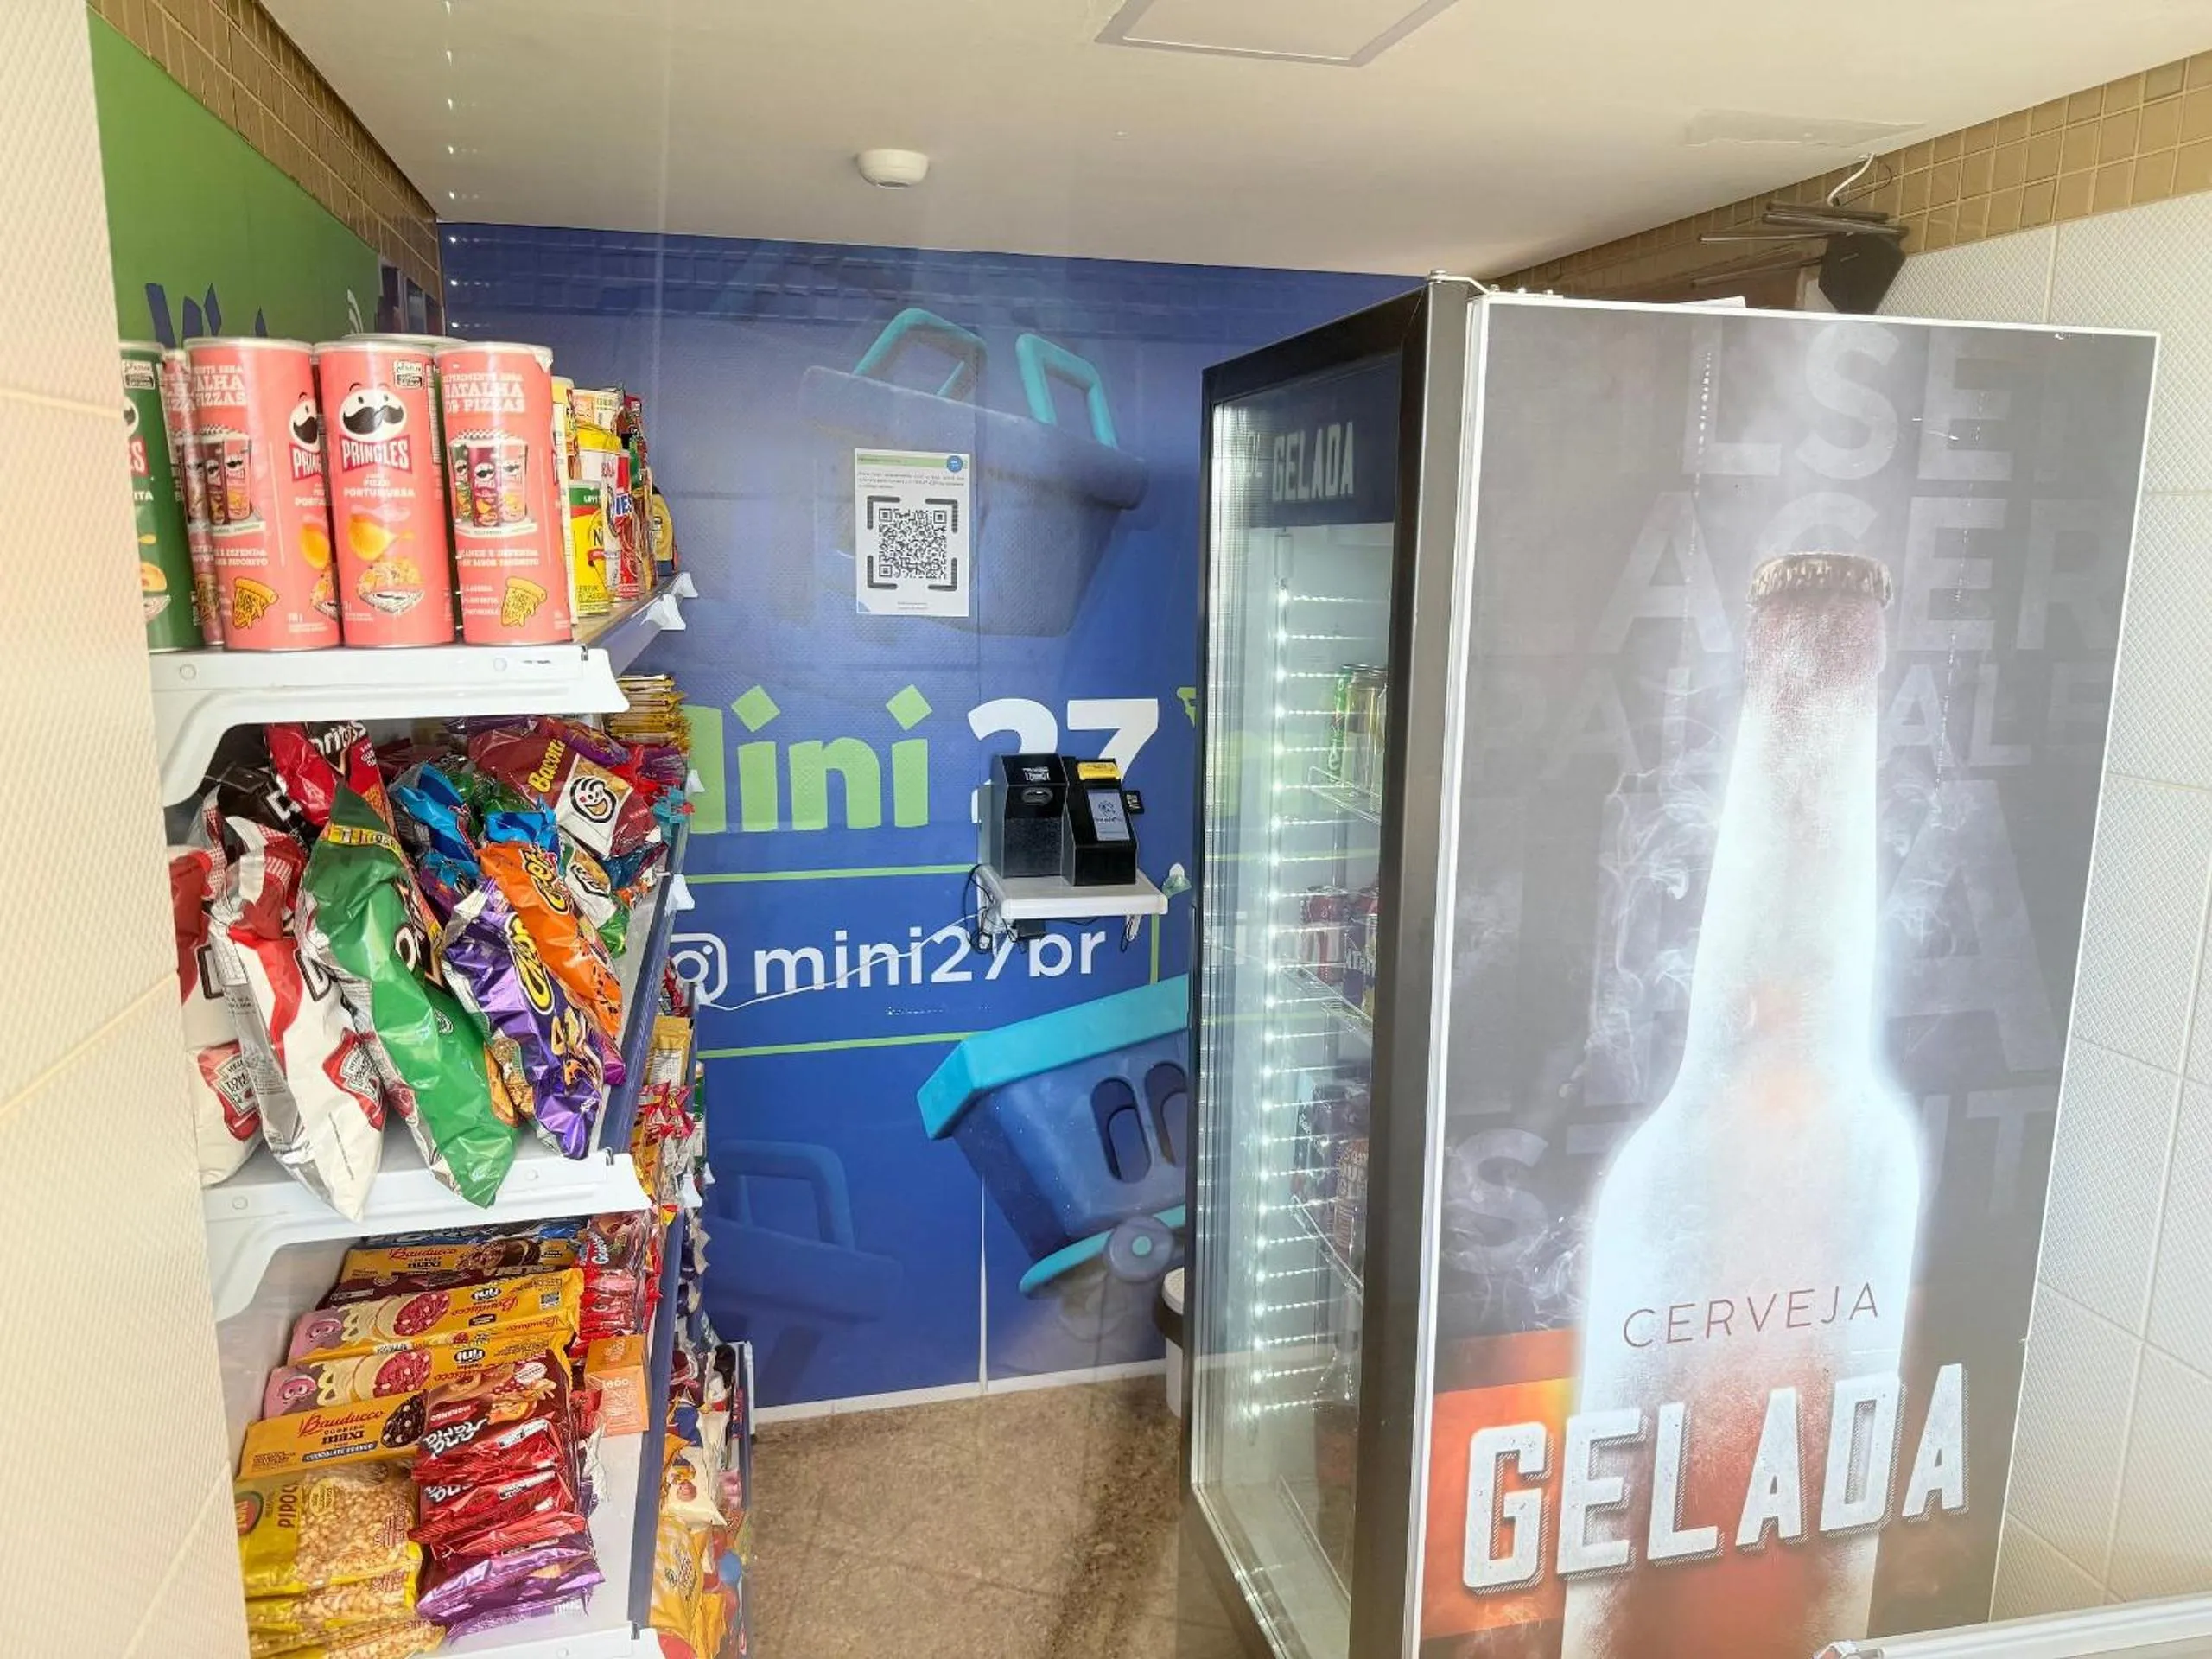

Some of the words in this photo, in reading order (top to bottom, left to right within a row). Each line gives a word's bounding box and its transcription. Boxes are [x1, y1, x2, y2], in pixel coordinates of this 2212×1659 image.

[340, 439, 410, 472] PRINGLES
[1273, 421, 1354, 503] GELADA
[1623, 1282, 1880, 1351] CERVEJA
[297, 1410, 385, 1439] Bauducco
[277, 1477, 298, 1529] PIPOC
[1463, 1363, 1969, 1596] GELADA
